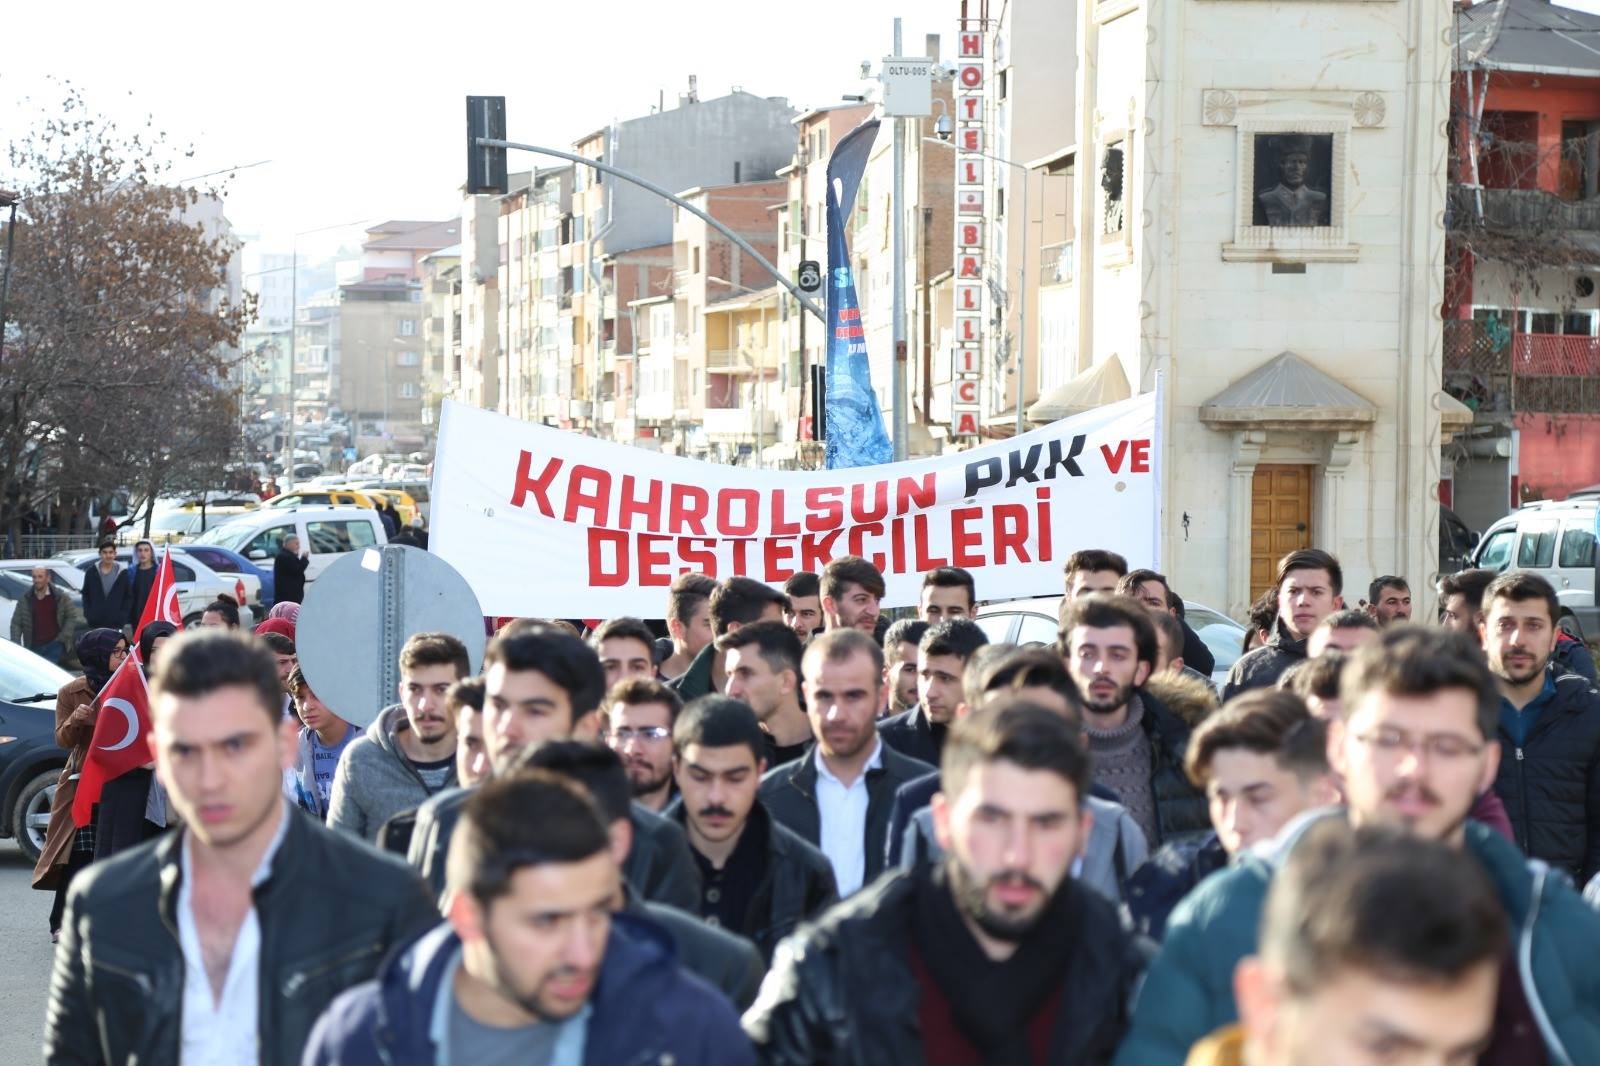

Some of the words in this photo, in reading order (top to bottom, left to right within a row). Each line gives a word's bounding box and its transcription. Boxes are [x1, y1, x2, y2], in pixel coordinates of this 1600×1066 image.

[889, 66, 928, 76] OLTU-005
[961, 35, 982, 182] HOTEL
[510, 450, 936, 536] KAHROLSUN
[964, 434, 1086, 499] PKK
[1100, 439, 1151, 474] VE
